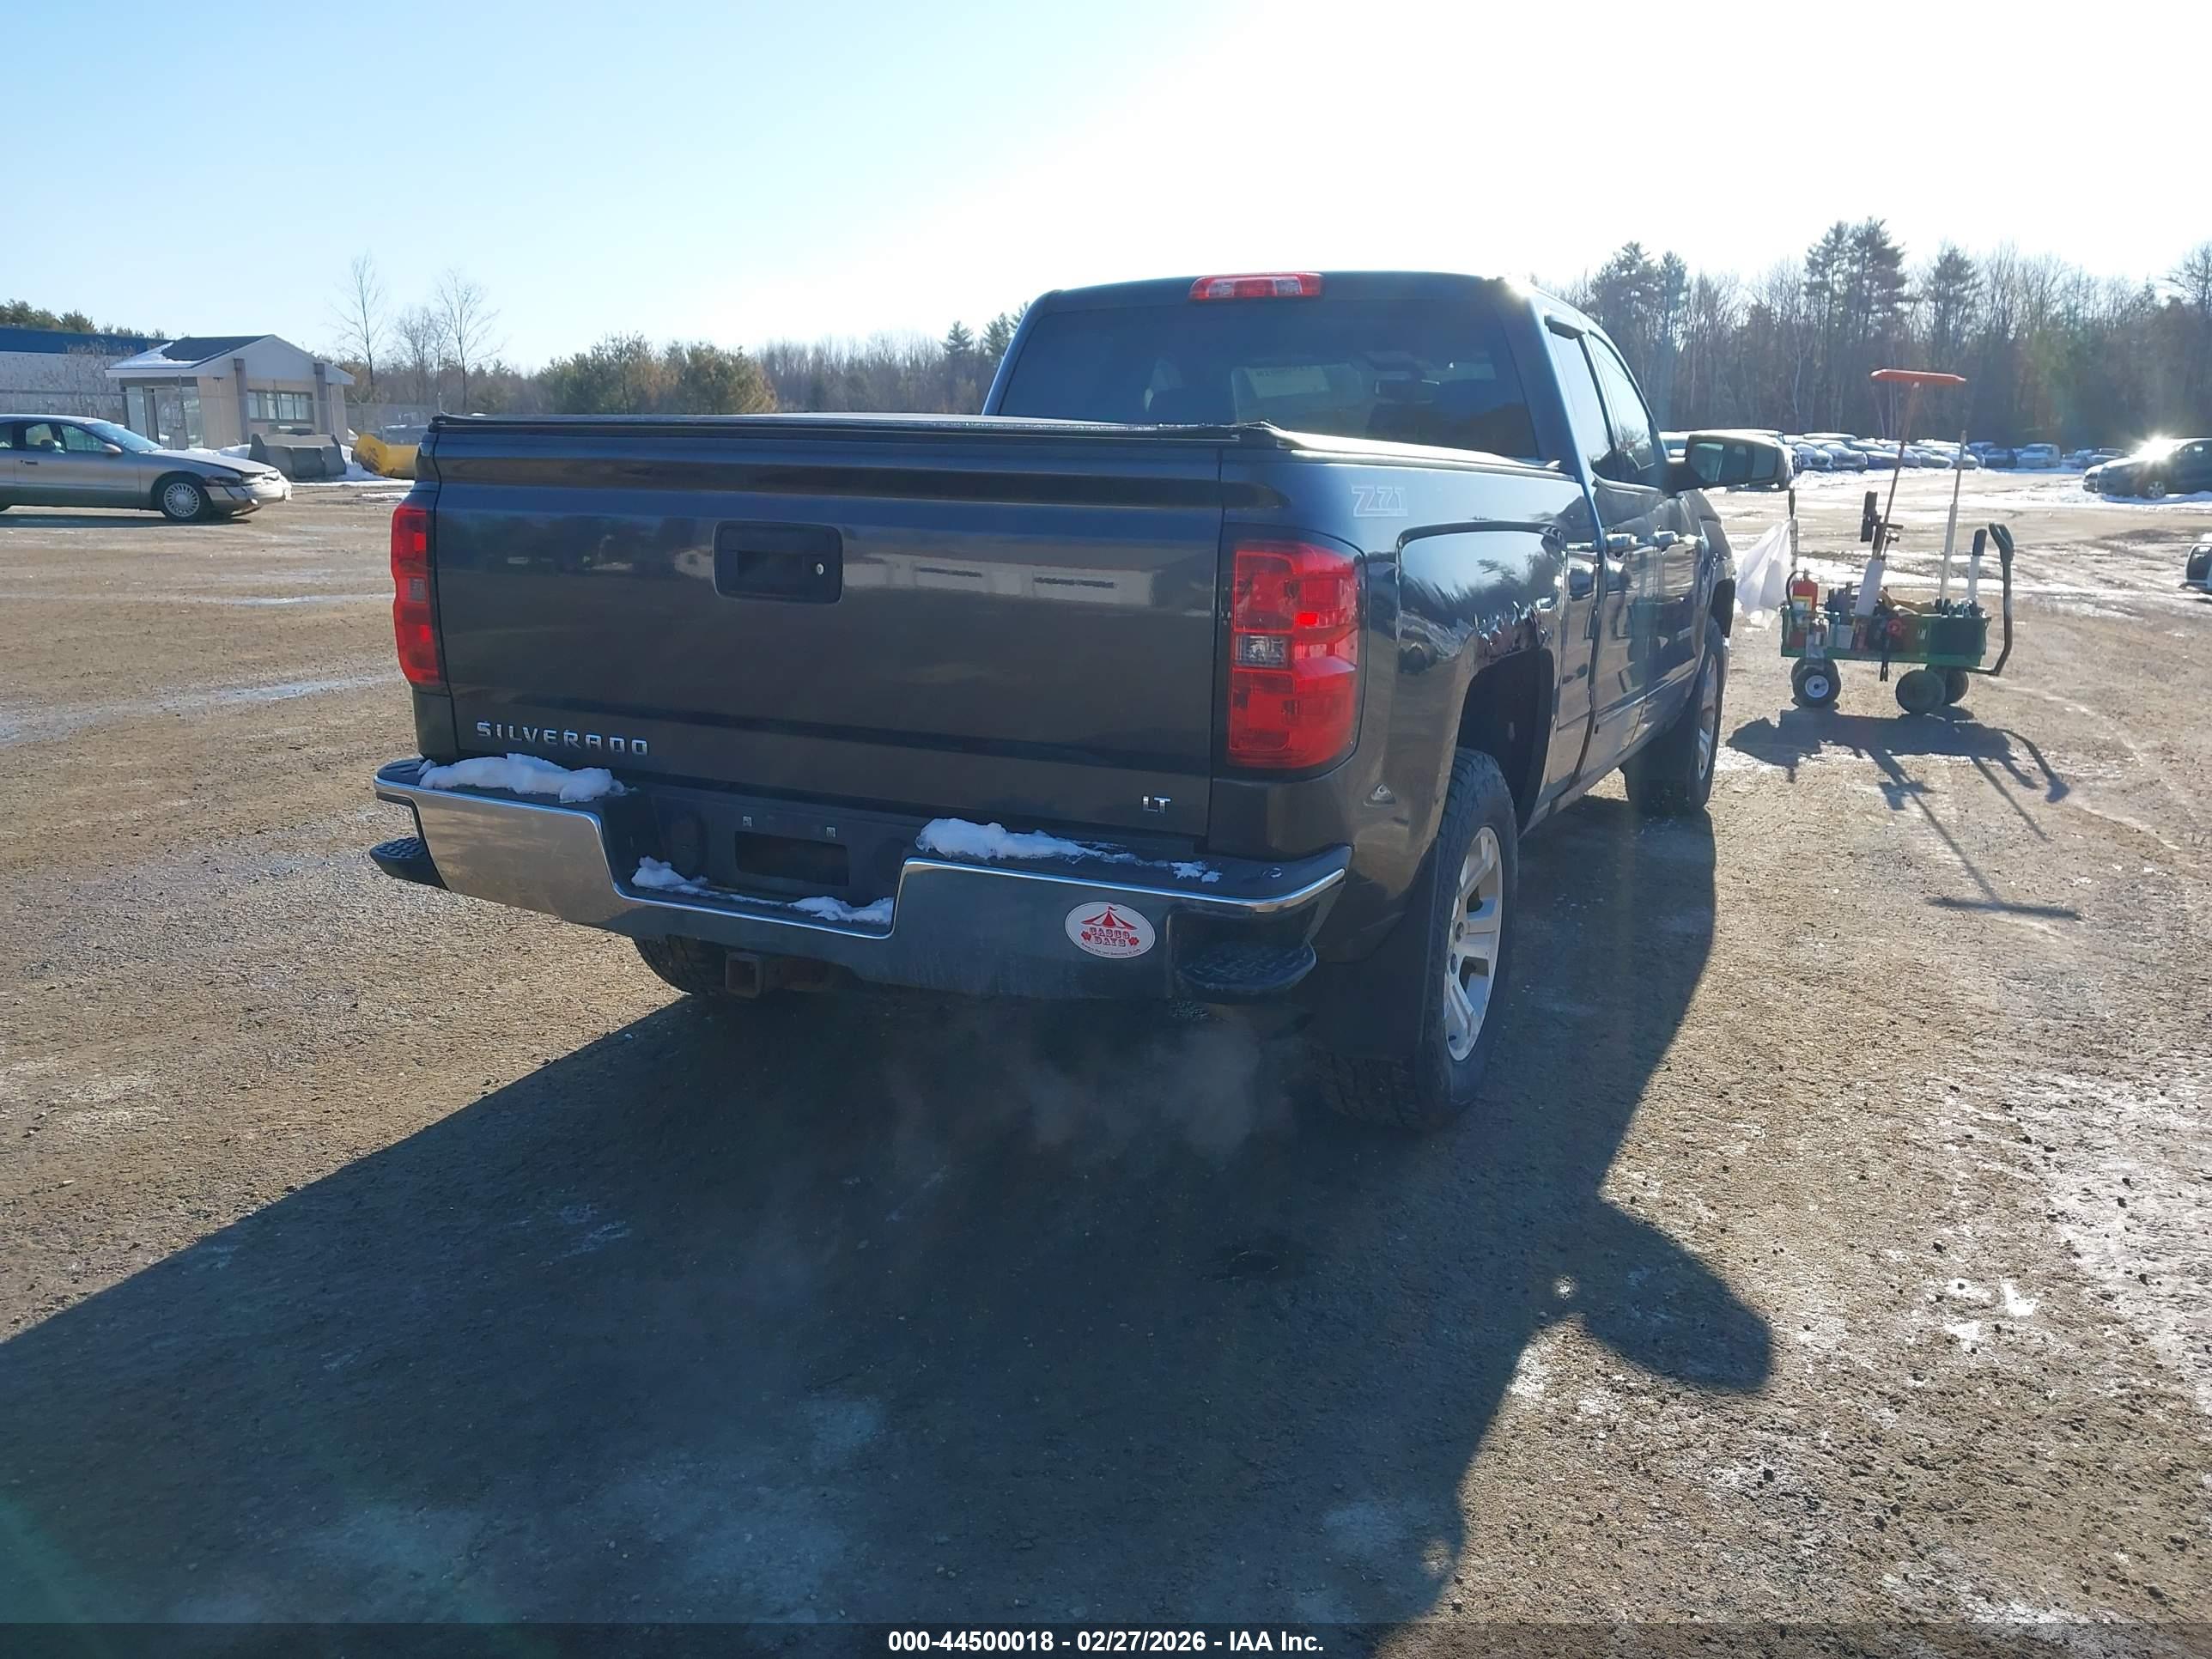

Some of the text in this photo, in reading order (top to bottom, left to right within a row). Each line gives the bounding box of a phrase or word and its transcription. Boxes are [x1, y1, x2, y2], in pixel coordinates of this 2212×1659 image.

[477, 721, 648, 756] SILVERADO
[1142, 795, 1171, 814] LT
[1094, 936, 1126, 947] DAYS
